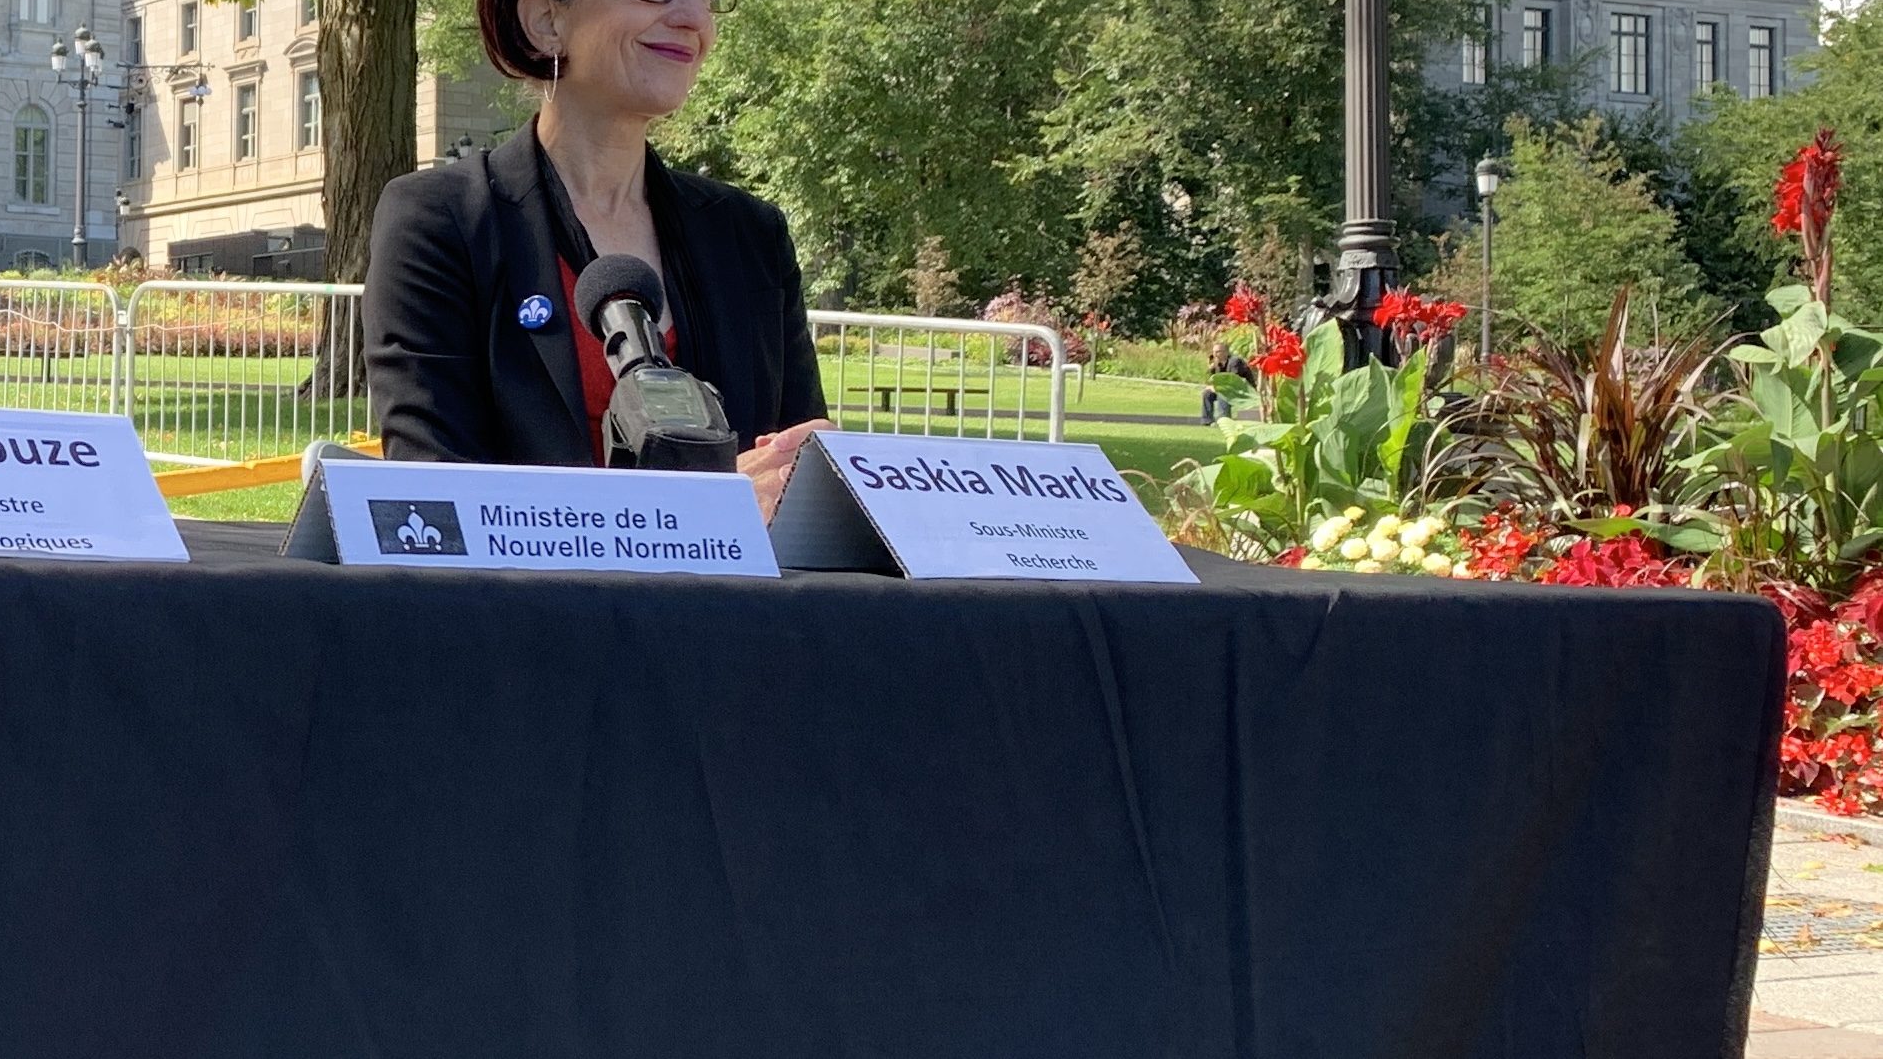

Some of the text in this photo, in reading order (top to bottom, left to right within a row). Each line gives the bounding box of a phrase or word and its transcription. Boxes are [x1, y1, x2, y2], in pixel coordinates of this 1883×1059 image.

[850, 455, 1128, 503] Saskia Marks
[480, 505, 678, 530] Ministère de la
[969, 521, 1089, 541] Sous-Ministre
[488, 534, 743, 560] Nouvelle Normalité
[1006, 553, 1098, 571] Recherche
